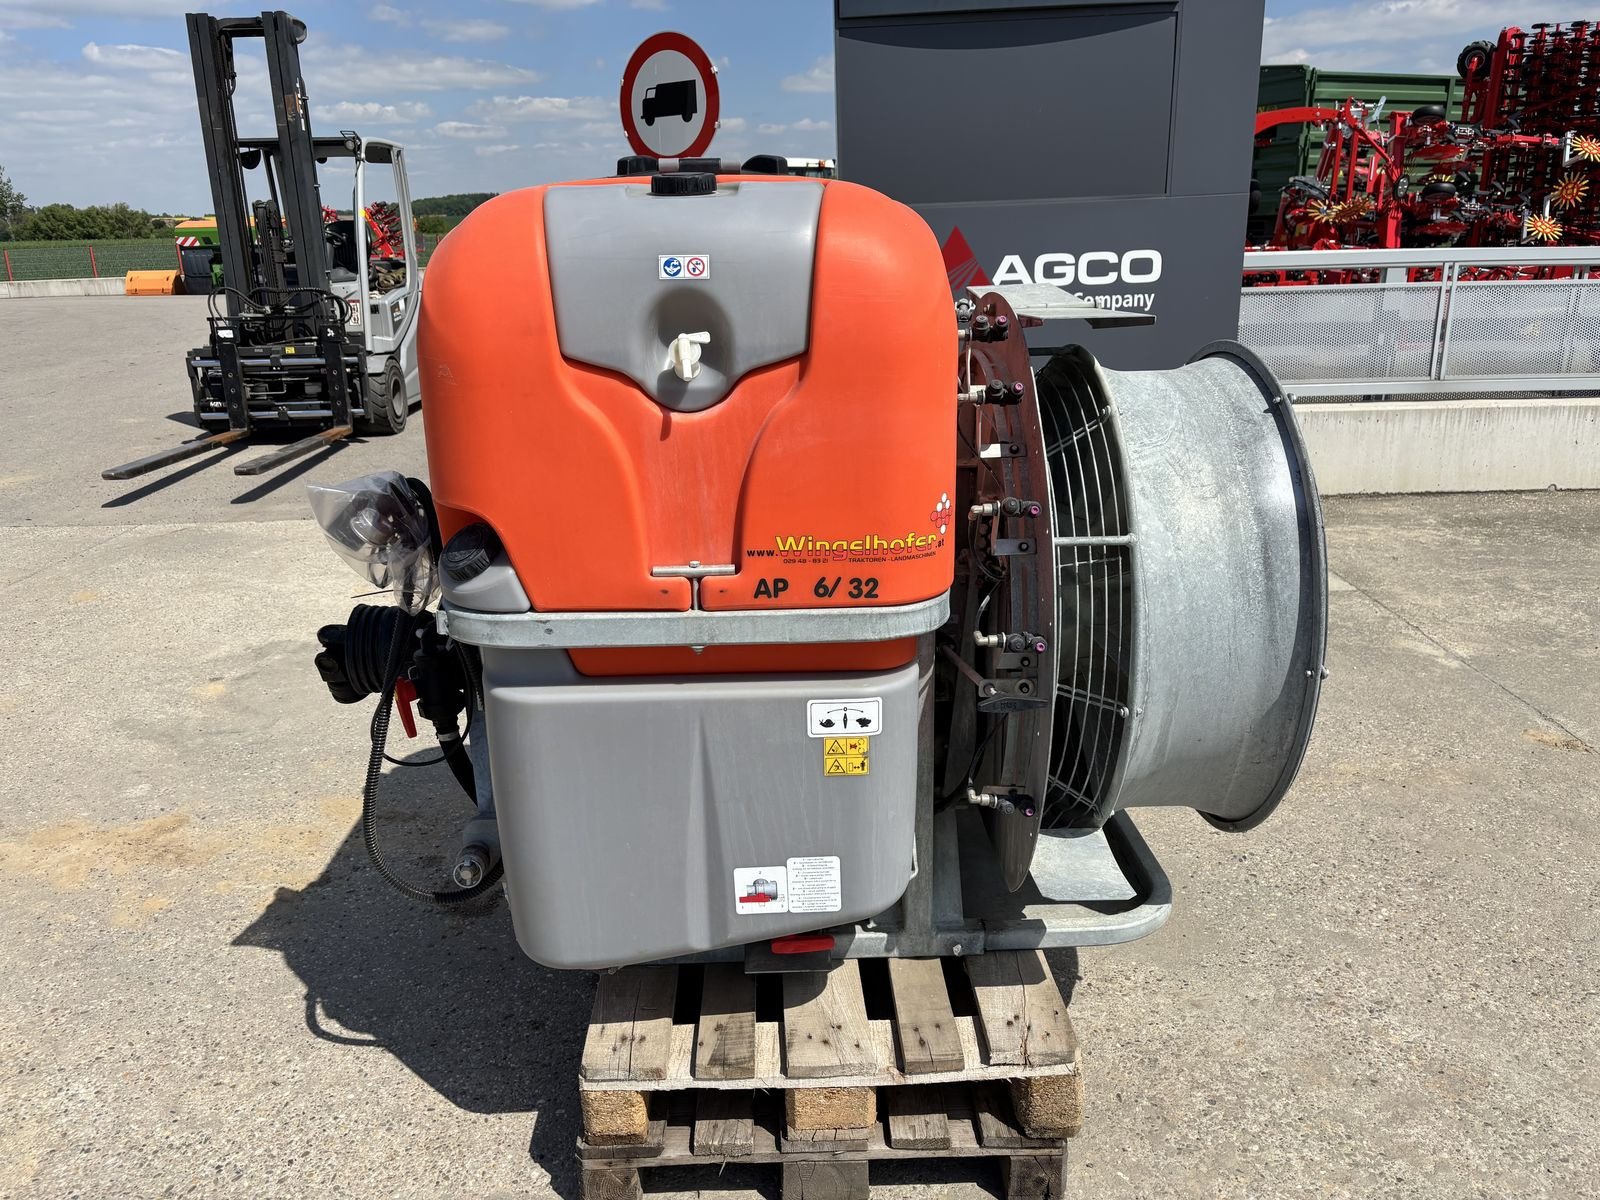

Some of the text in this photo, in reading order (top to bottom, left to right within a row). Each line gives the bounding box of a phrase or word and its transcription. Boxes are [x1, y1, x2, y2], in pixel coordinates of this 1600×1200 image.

[992, 249, 1163, 286] AGCO
[753, 577, 789, 599] AP
[848, 577, 879, 599] 32
